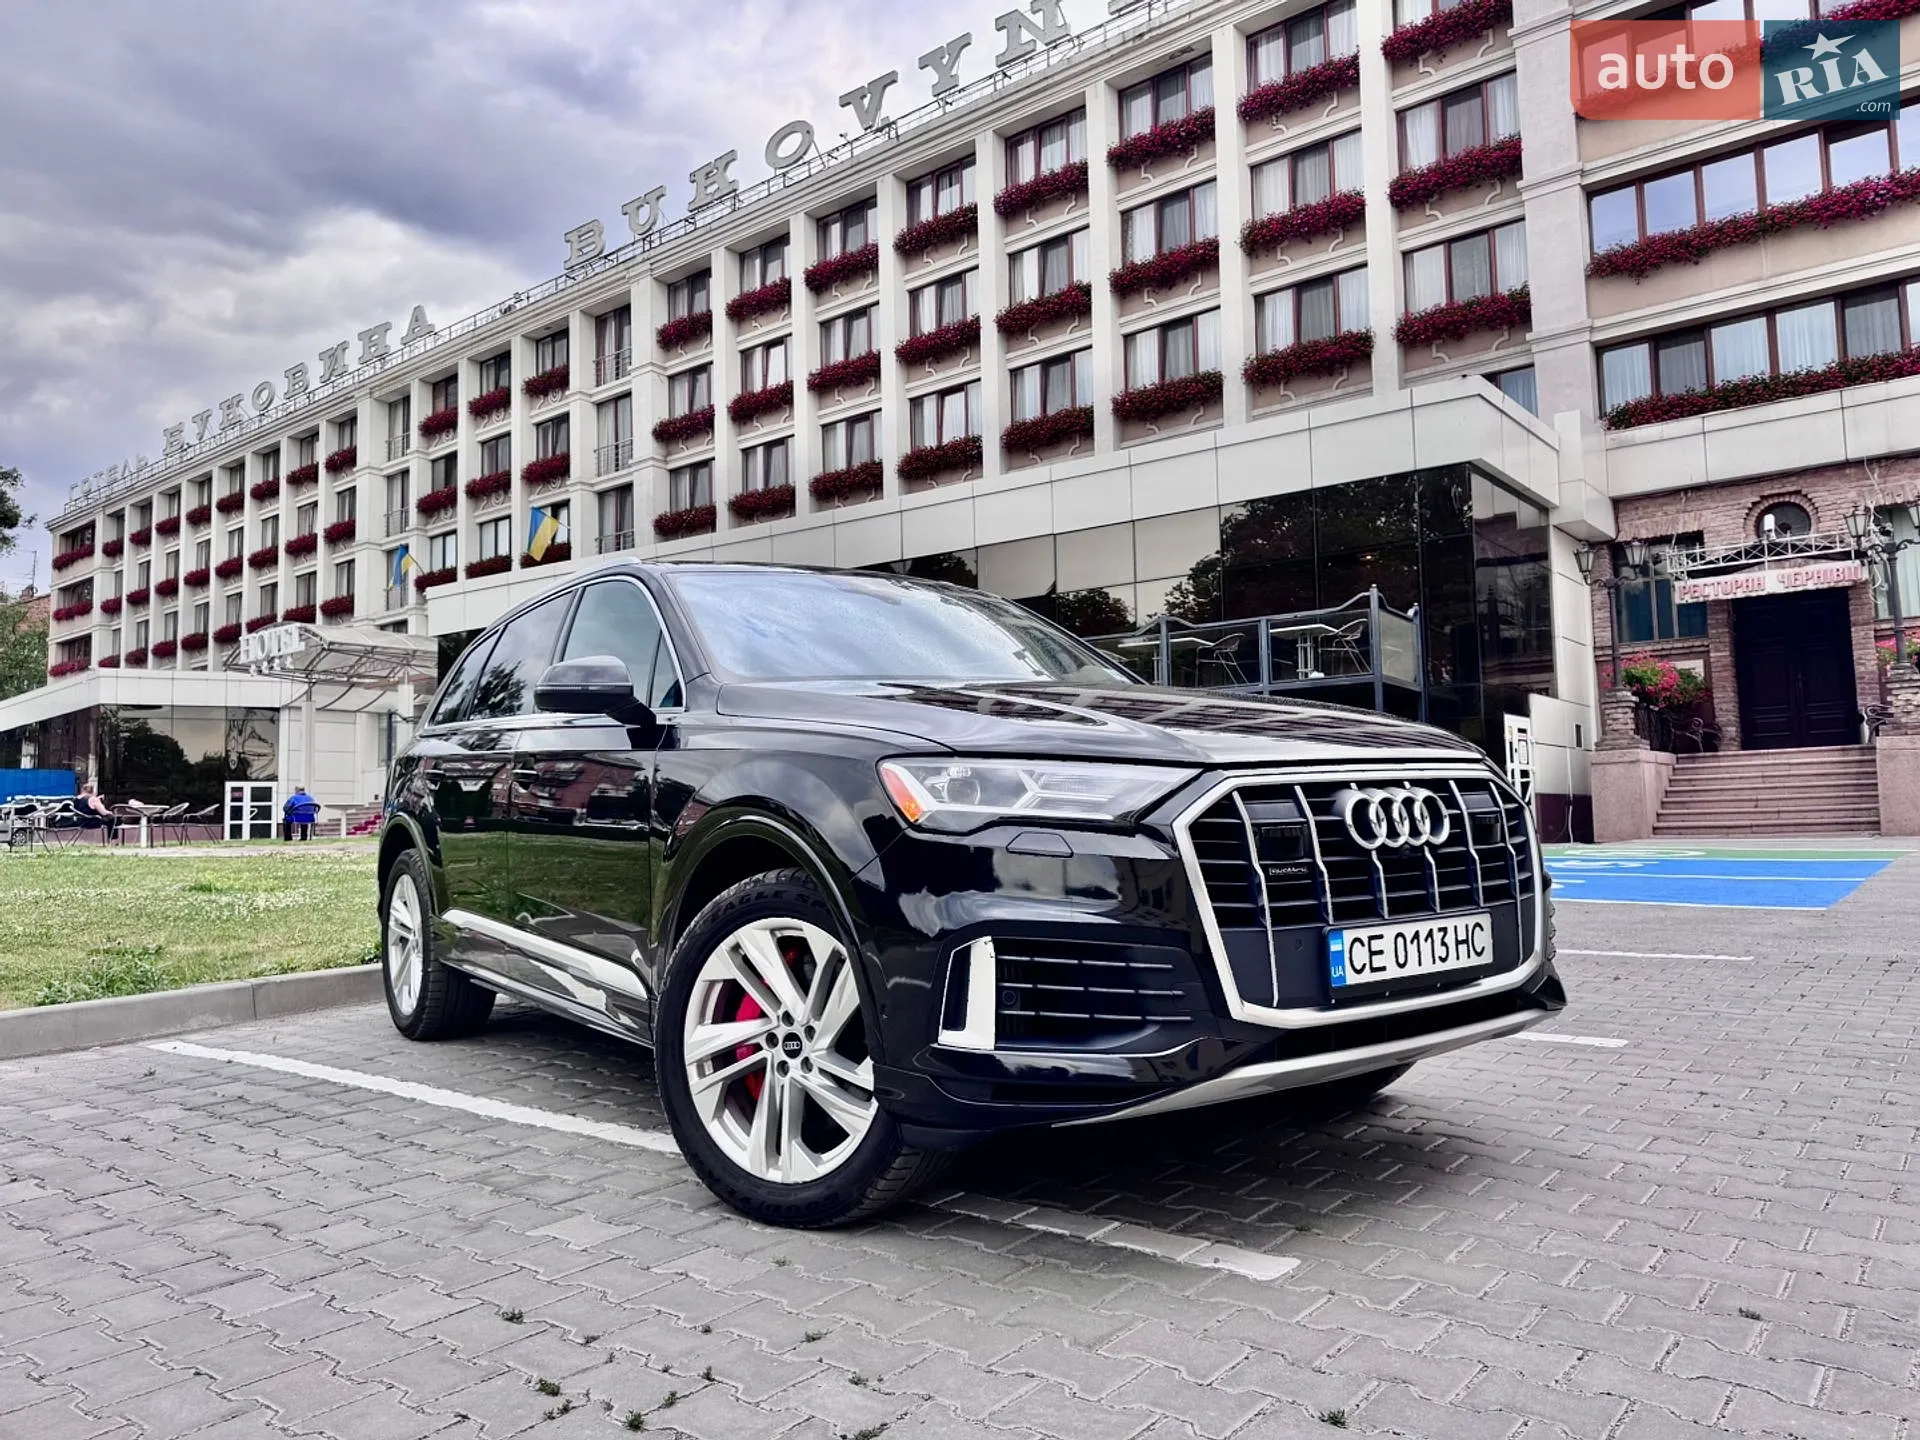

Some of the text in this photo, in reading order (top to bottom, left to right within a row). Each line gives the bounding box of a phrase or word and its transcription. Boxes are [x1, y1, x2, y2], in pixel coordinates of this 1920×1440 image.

[563, 0, 1146, 270] BUKOVYN
[162, 304, 435, 457] БУКОВИНА
[1678, 575, 1766, 600] РЕСТОРАН
[239, 622, 305, 665] HOTEL
[1331, 965, 1345, 978] UA
[1349, 922, 1486, 975] CE 0113 HC
